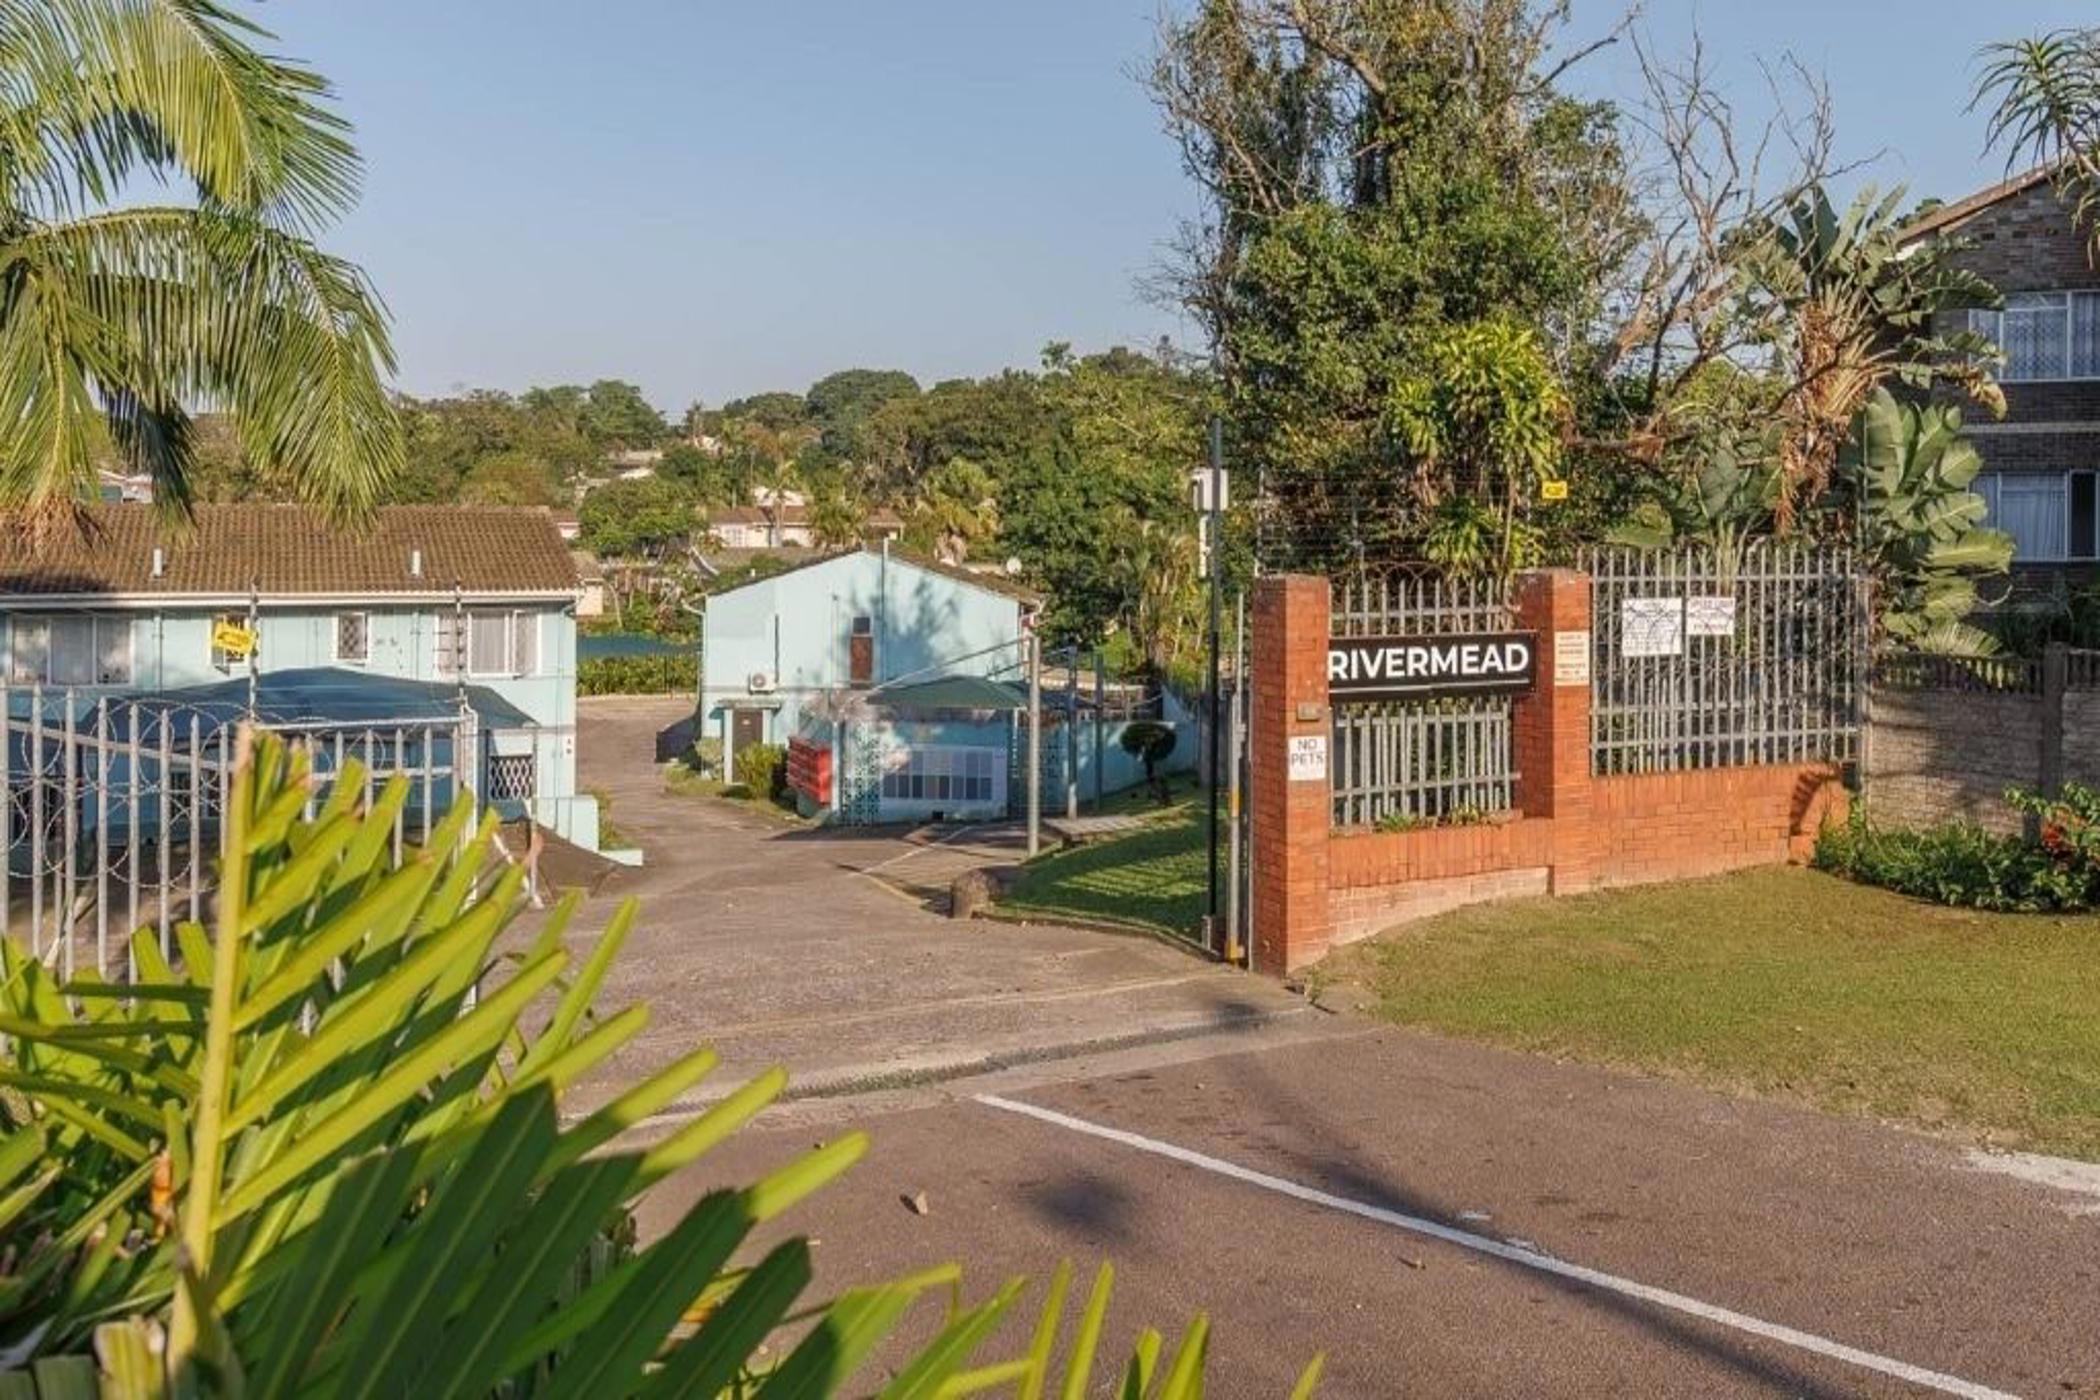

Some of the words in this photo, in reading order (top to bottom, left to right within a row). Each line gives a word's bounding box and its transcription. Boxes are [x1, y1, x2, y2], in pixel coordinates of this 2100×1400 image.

[1328, 643, 1529, 681] RIVERMEAD
[1297, 739, 1318, 751] NO
[1291, 752, 1324, 766] PETS
